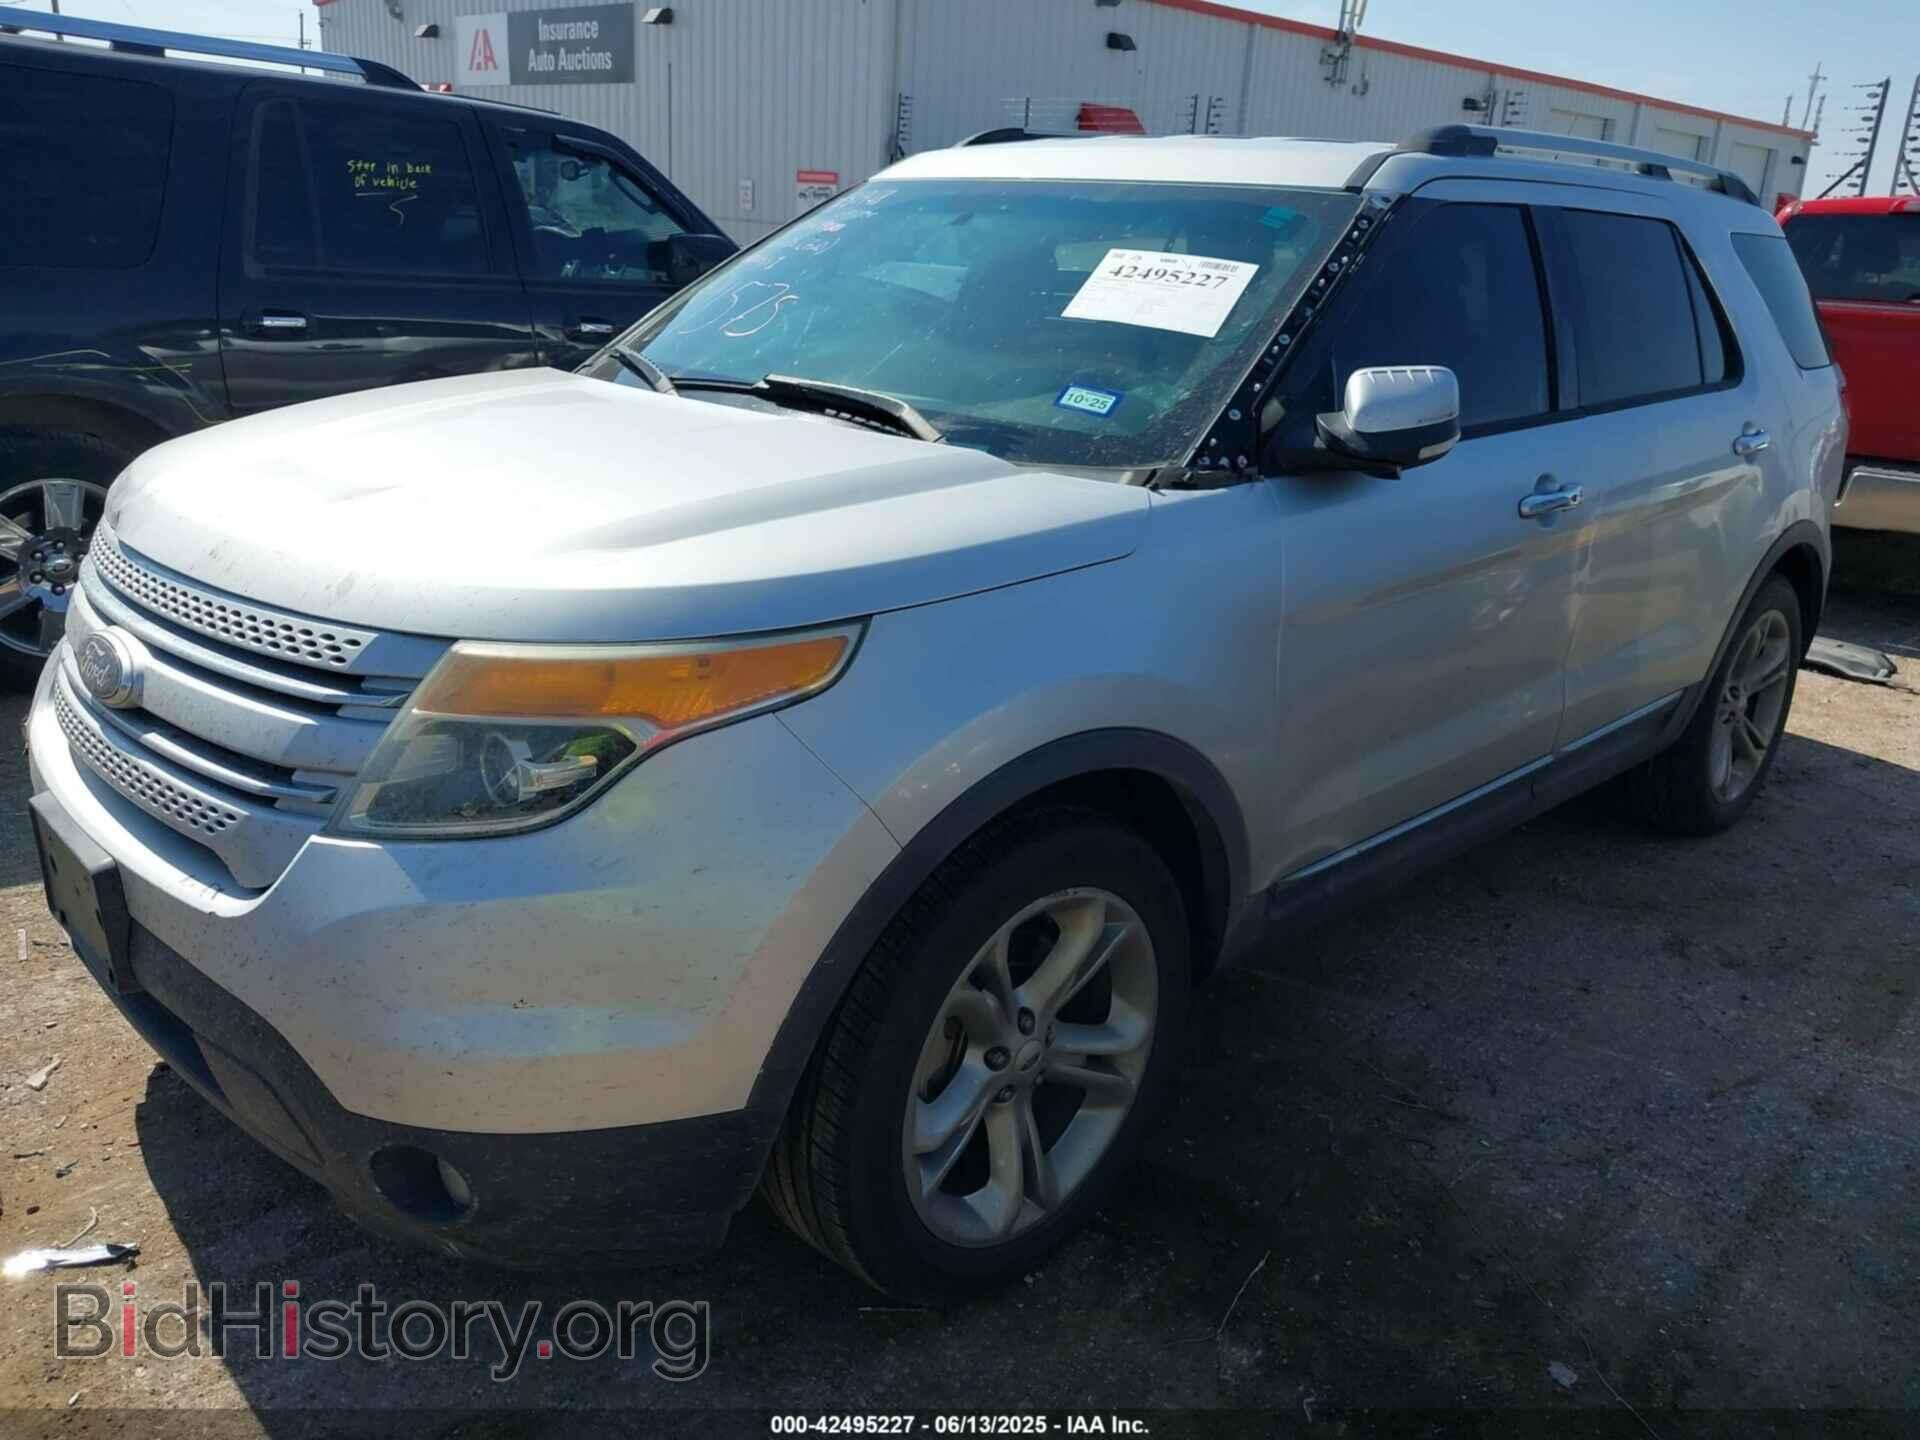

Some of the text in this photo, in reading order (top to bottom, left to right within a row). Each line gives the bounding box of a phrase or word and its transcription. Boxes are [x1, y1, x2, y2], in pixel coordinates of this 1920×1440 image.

[538, 18, 599, 41] Insurance
[527, 46, 613, 72] Auto Auctions
[1108, 263, 1228, 290] 42495227
[1067, 393, 1109, 410] 10 25
[80, 641, 111, 688] Ford
